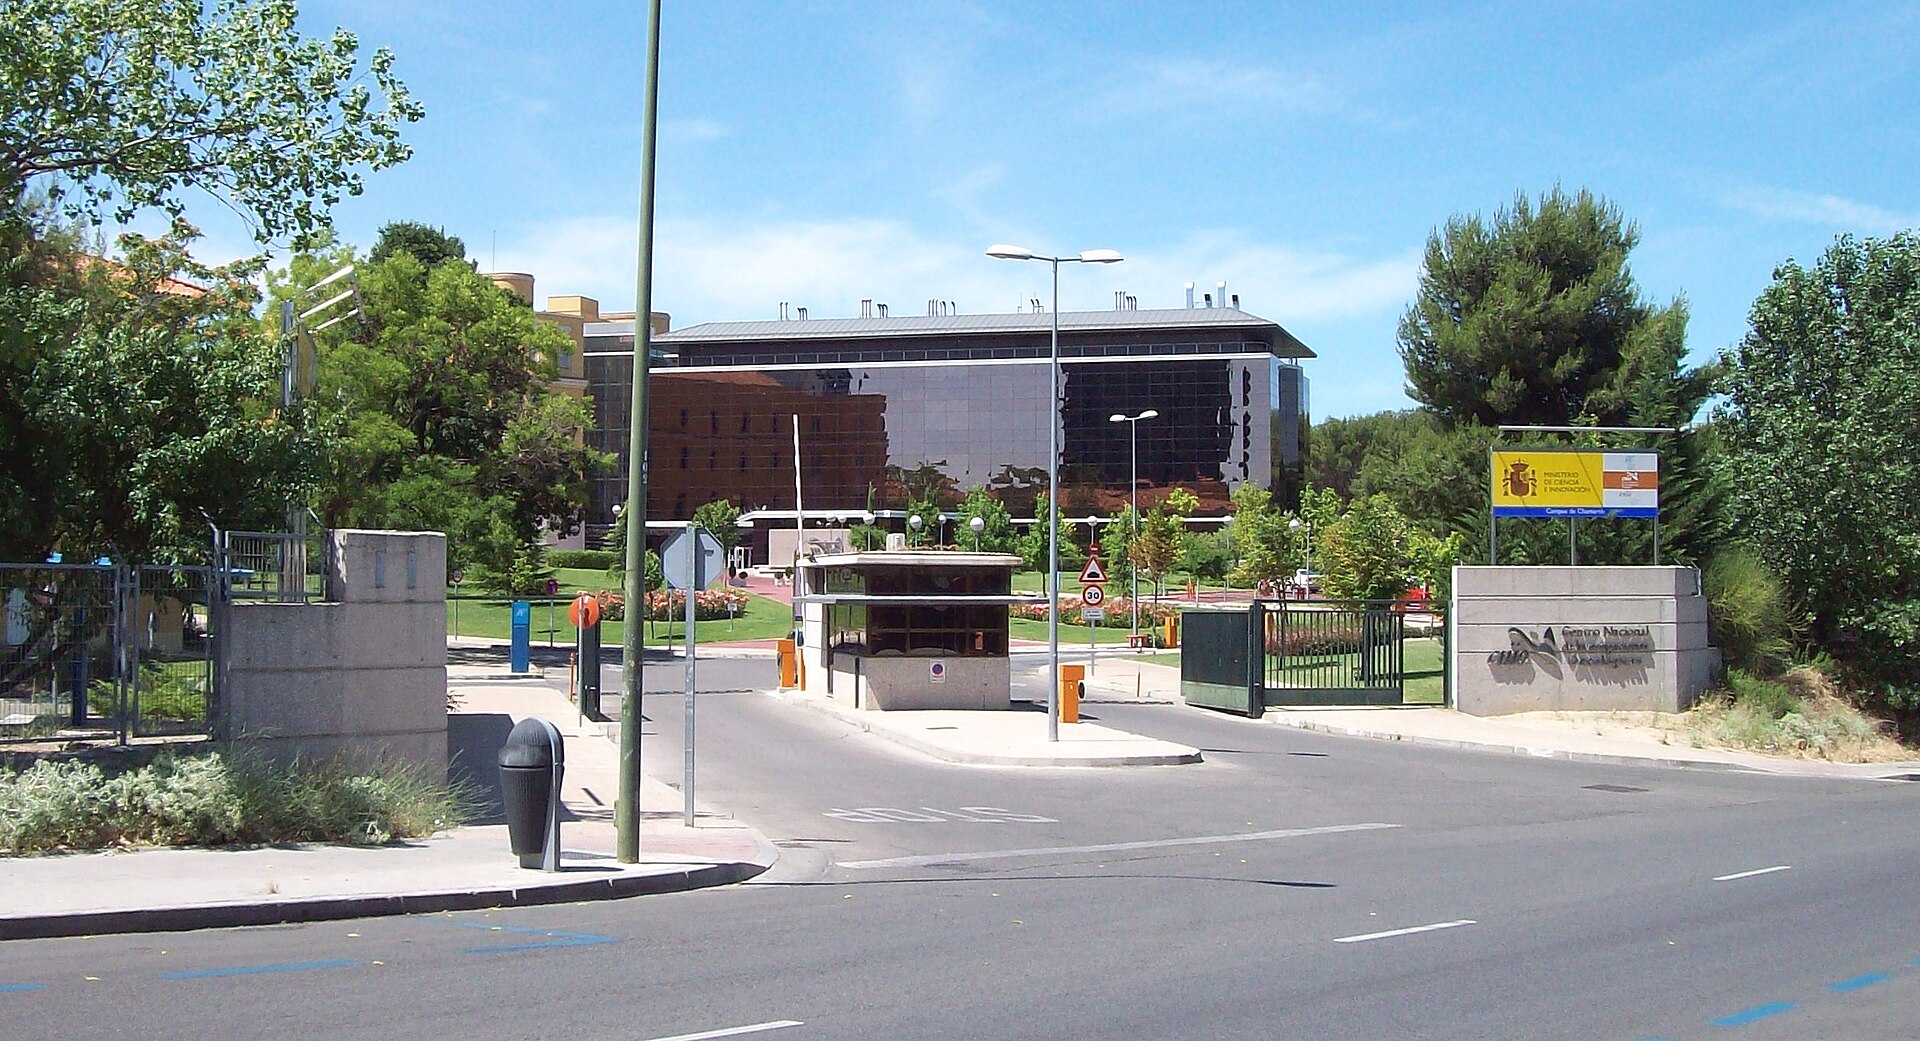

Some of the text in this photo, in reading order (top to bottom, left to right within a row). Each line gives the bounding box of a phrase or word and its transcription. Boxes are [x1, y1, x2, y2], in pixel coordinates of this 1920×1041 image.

[1087, 591, 1100, 600] 30
[1562, 624, 1650, 636] Centro Nacional
[822, 806, 1059, 823] STOP
